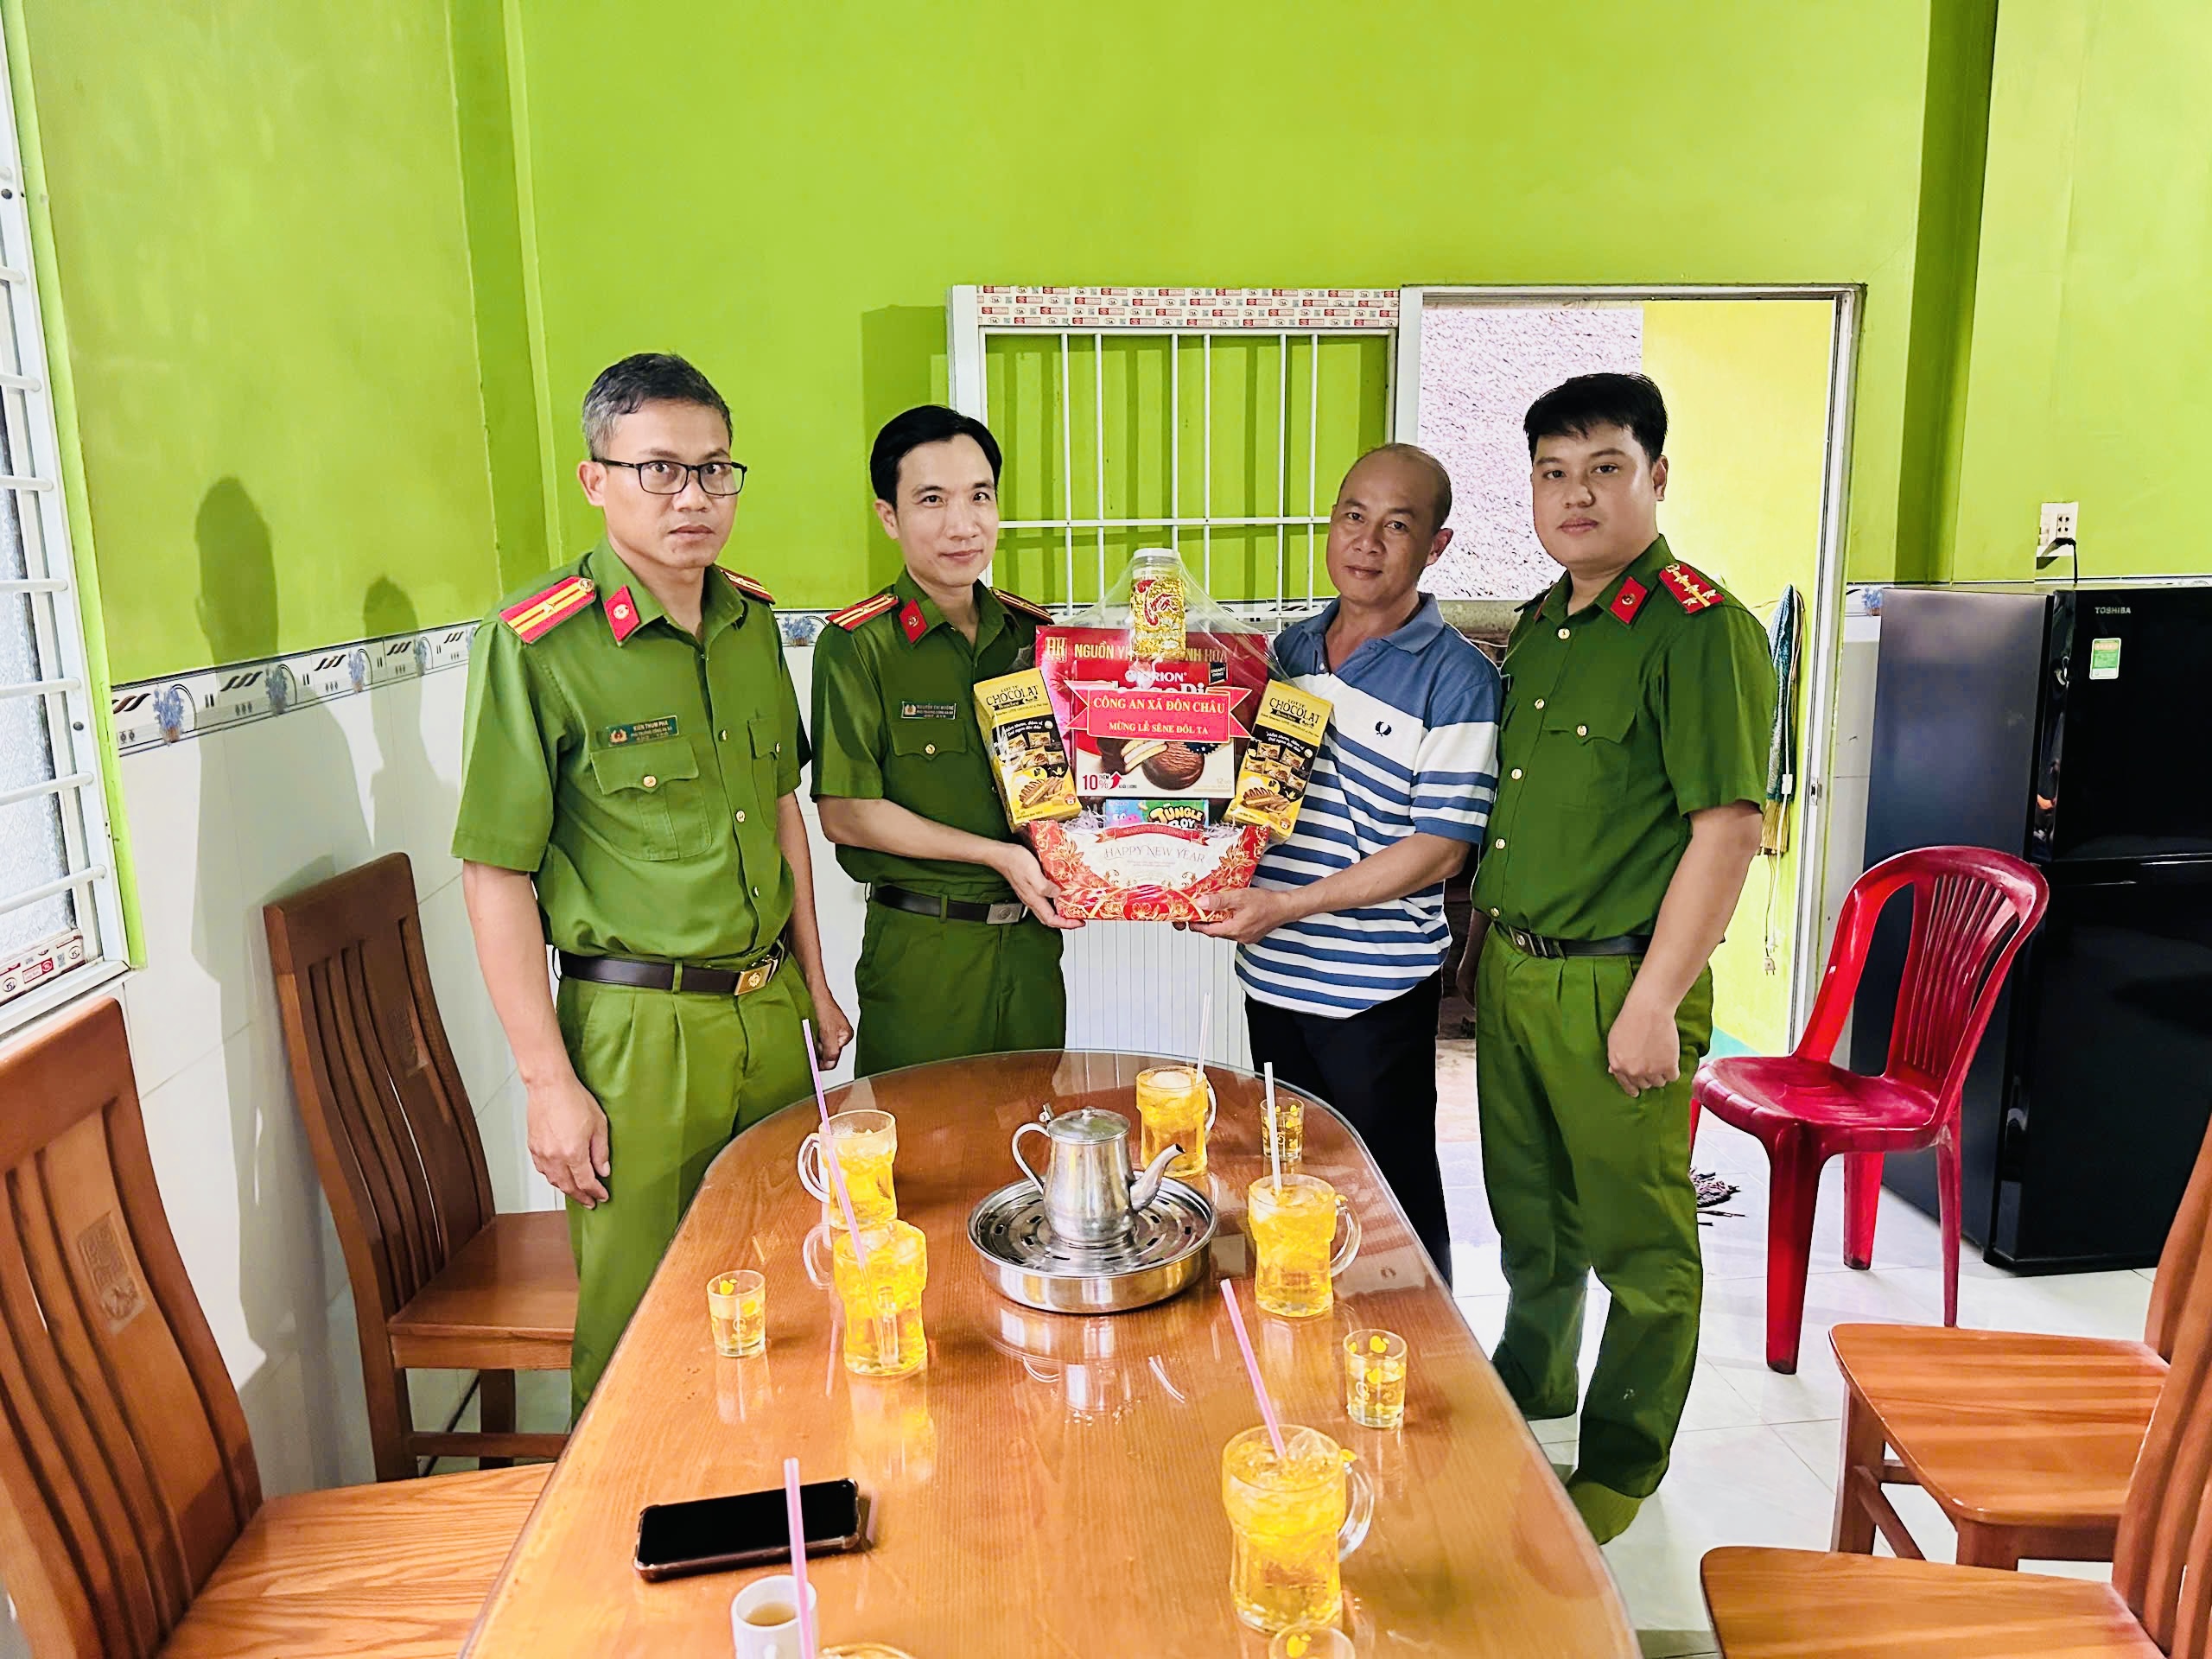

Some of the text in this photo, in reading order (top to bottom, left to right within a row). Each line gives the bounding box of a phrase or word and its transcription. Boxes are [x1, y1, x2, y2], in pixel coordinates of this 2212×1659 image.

[1074, 640, 1114, 659] NGUỒN
[986, 685, 1039, 705] CHOCOLAT
[1093, 694, 1225, 714] CÔNG AN XÃ ĐÔN CHÂU
[1269, 697, 1321, 724] CHOCOLAT
[1109, 720, 1136, 732] MỪNG
[1152, 722, 1174, 734] SÊNE
[1197, 726, 1209, 734] TA
[1149, 805, 1203, 824] JUNGLE
[1104, 845, 1206, 863] HAPPY NEW YEAR
